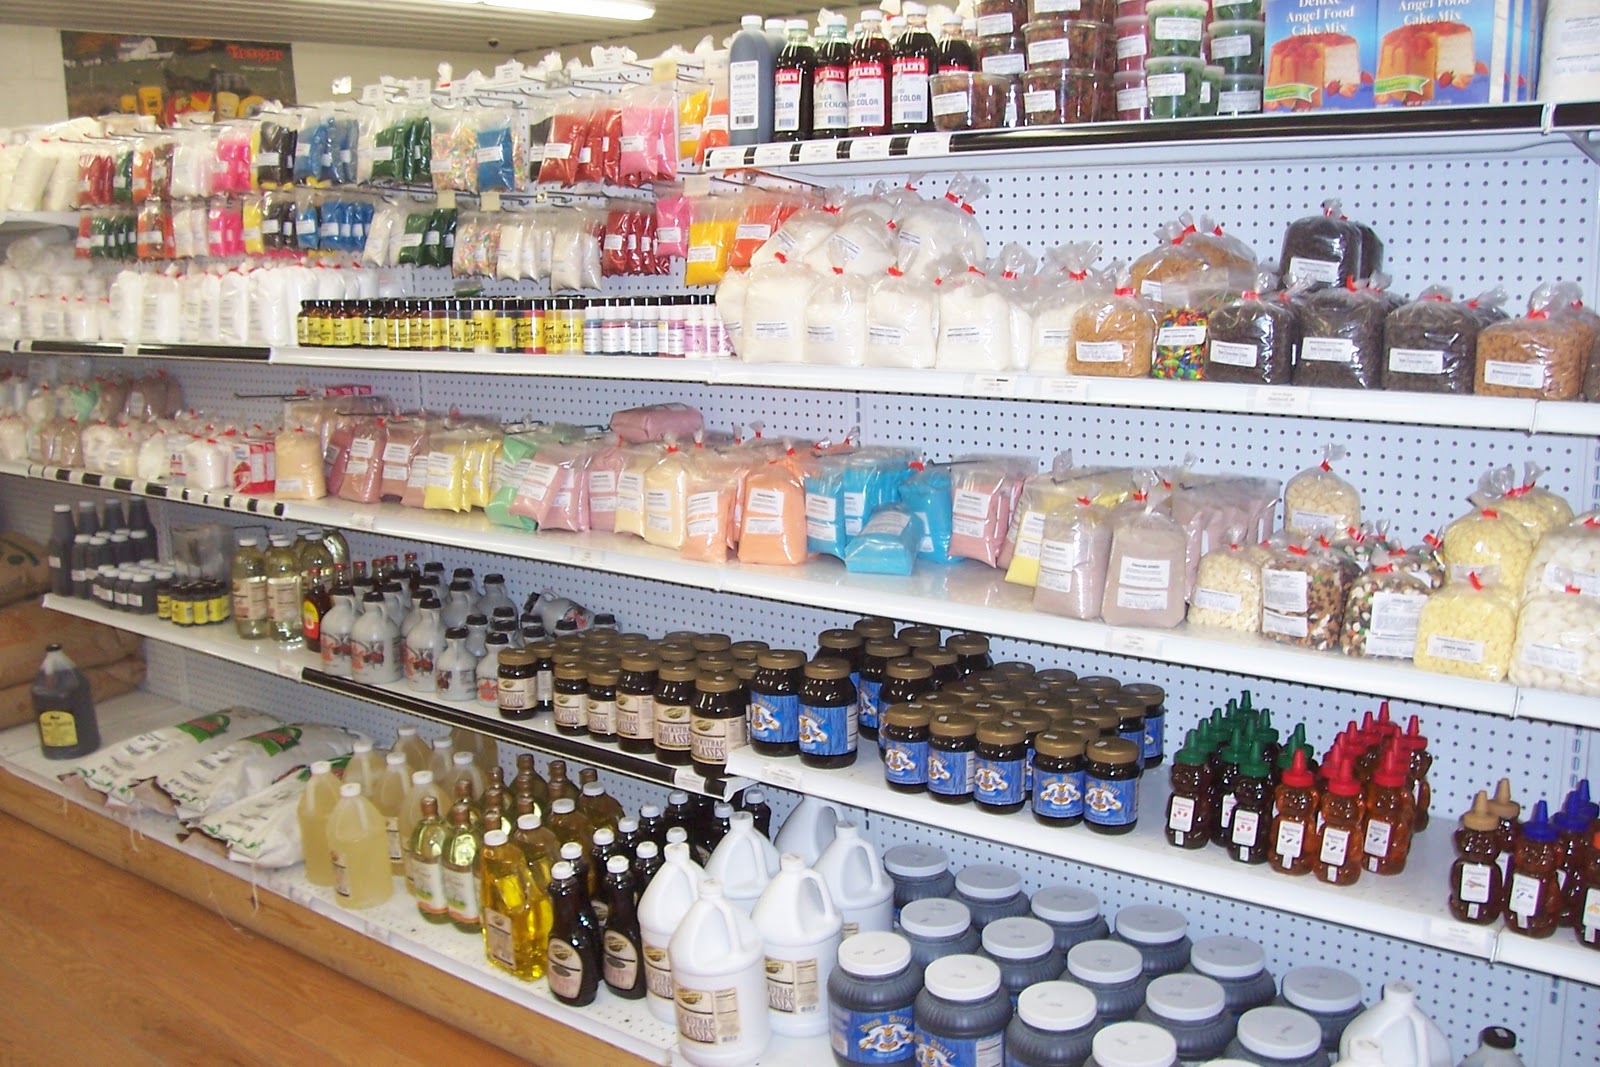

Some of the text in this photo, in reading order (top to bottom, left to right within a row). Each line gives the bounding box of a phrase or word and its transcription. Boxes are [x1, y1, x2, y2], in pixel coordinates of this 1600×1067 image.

[1399, 0, 1433, 11] Angel
[1286, 6, 1354, 23] Angel Food
[1403, 10, 1462, 25] Cake Mix
[1291, 22, 1348, 36] Cake Mix
[848, 67, 882, 77] UTLER'S
[893, 61, 925, 73] UTLER'S
[856, 98, 878, 106] COLOR
[899, 94, 921, 102] COLOR
